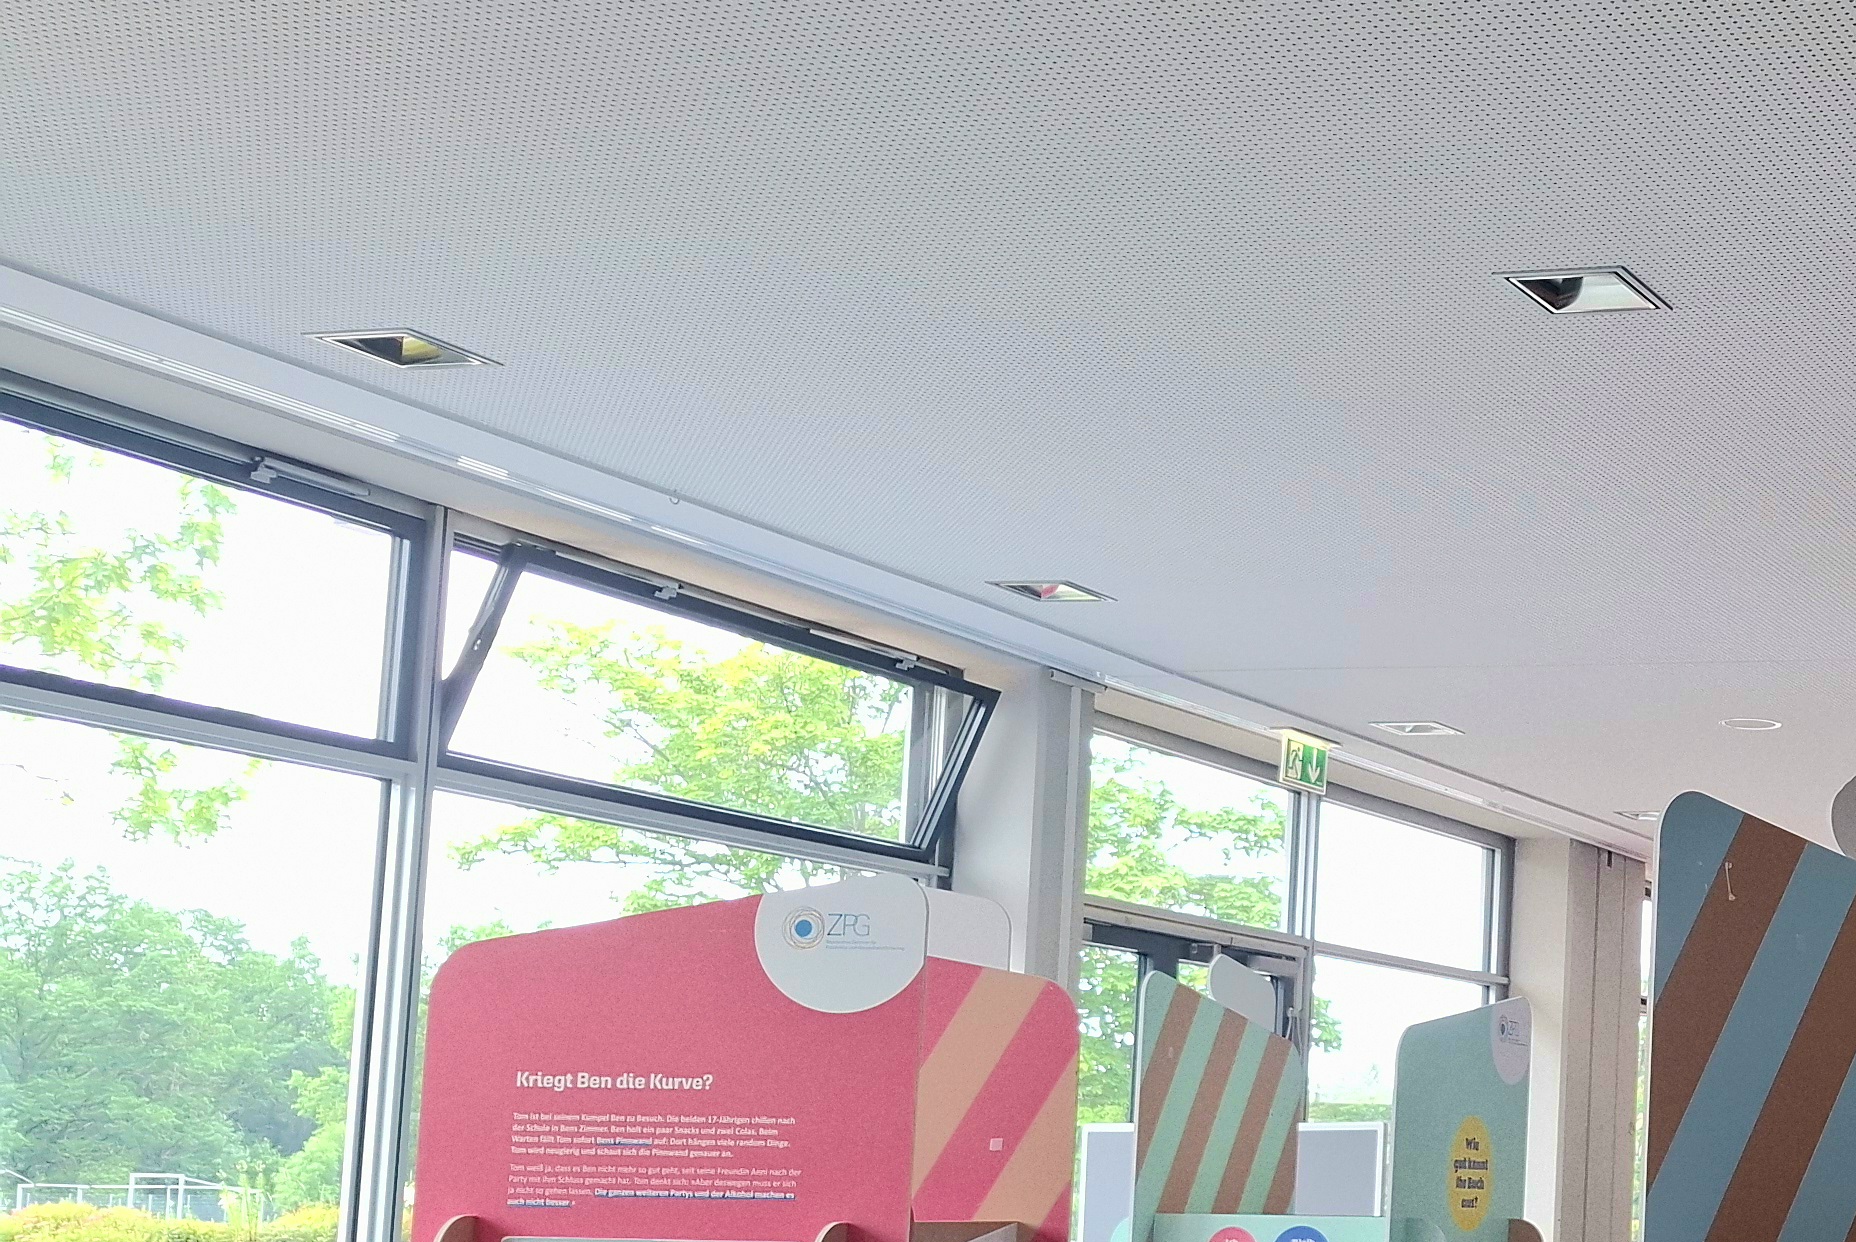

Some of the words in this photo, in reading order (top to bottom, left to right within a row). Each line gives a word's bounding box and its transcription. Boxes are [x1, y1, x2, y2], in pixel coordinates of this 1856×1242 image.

[826, 913, 871, 937] ZPG
[516, 1071, 573, 1092] Kriegt
[576, 1072, 612, 1088] Ben
[616, 1073, 646, 1089] die
[649, 1073, 713, 1090] Kurve?
